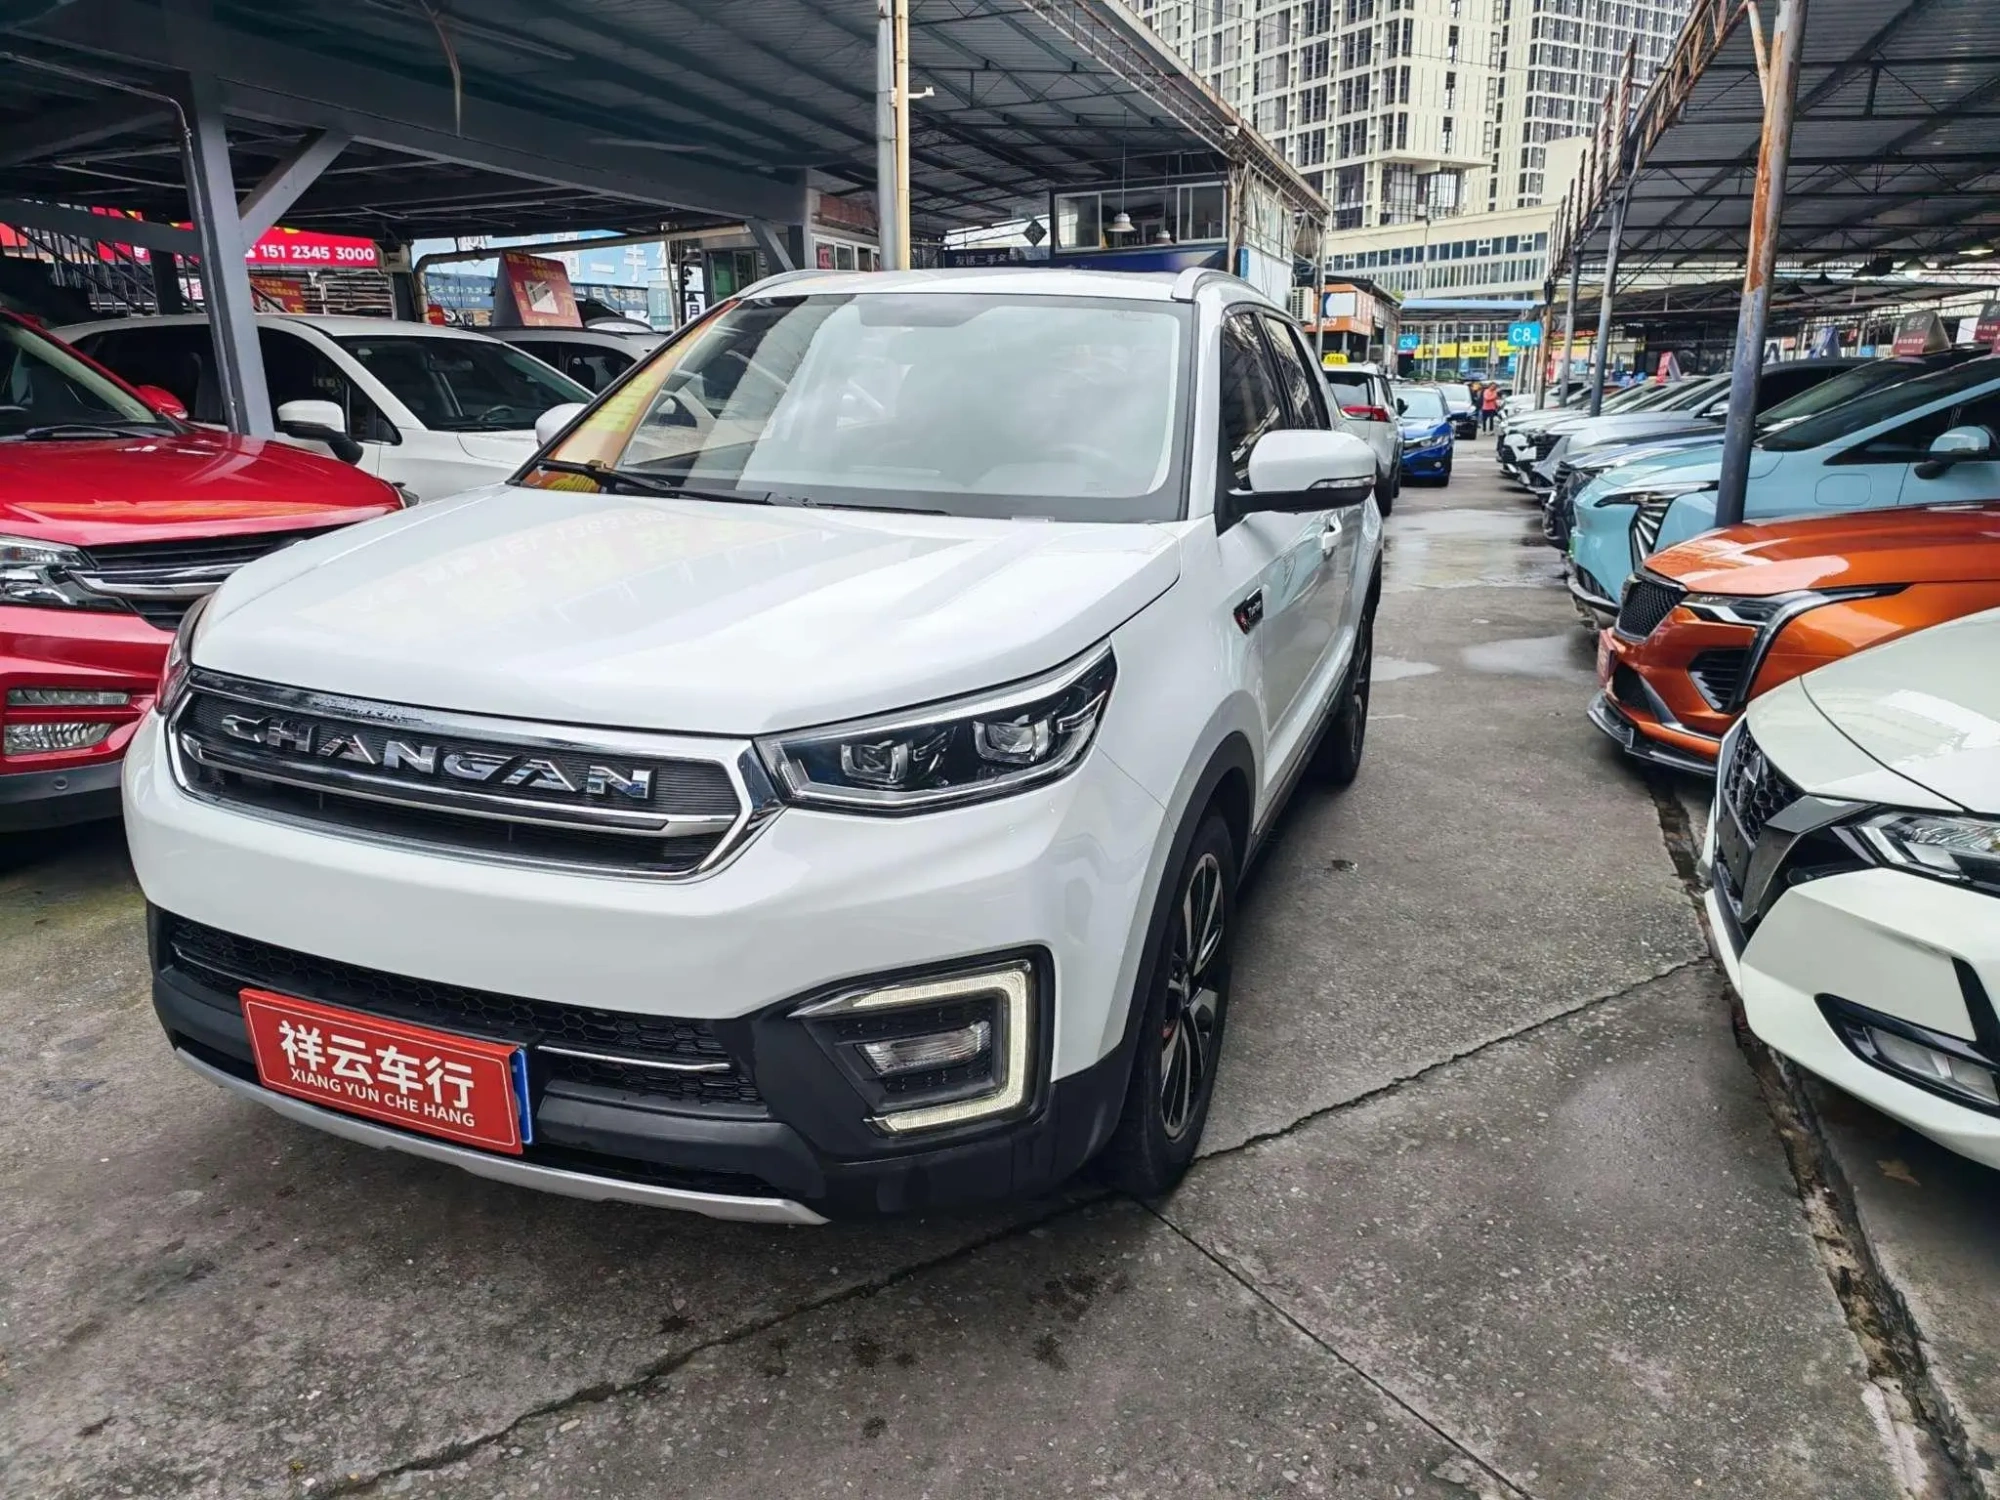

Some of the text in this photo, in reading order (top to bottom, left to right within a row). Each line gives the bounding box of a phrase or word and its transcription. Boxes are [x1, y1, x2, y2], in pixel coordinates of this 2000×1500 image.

[260, 244, 375, 261] 151 2345 3000
[220, 712, 659, 801] CHANGAN
[278, 1019, 475, 1109] 祥云车行
[291, 1066, 475, 1128] XIANG YUN CHE HANG
